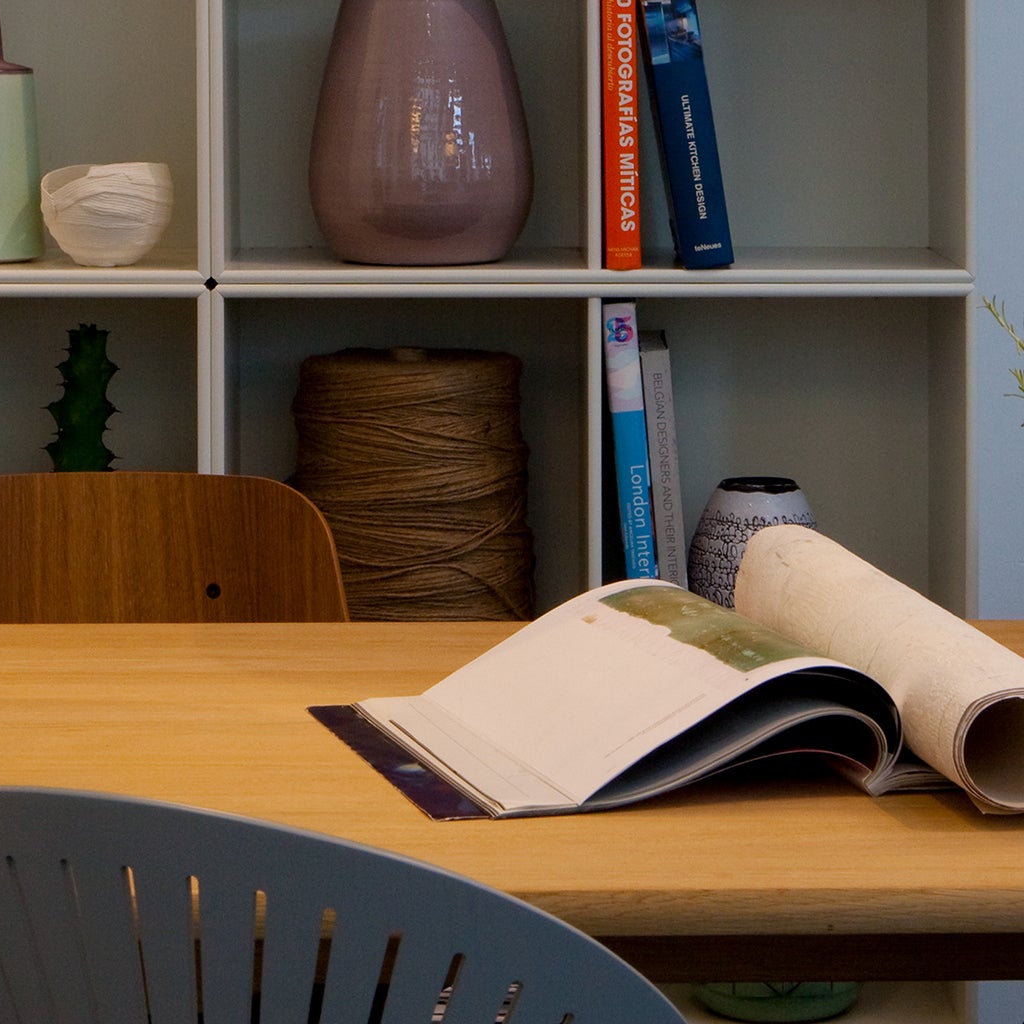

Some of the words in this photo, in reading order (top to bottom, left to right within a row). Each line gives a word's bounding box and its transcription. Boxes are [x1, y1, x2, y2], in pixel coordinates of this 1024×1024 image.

[607, 42, 615, 92] descubierto
[616, 12, 638, 148] FOTOGRAFÍAS
[680, 94, 696, 140] ULTIMATE
[688, 140, 702, 181] KITCHEN
[619, 152, 639, 233] MÍTICAS
[694, 183, 708, 220] DESIGN
[652, 372, 666, 420] BELGIAN
[656, 421, 672, 484] DESIGNERS
[629, 464, 646, 529] London
[662, 485, 674, 512] AND
[665, 513, 677, 543] THEIR
